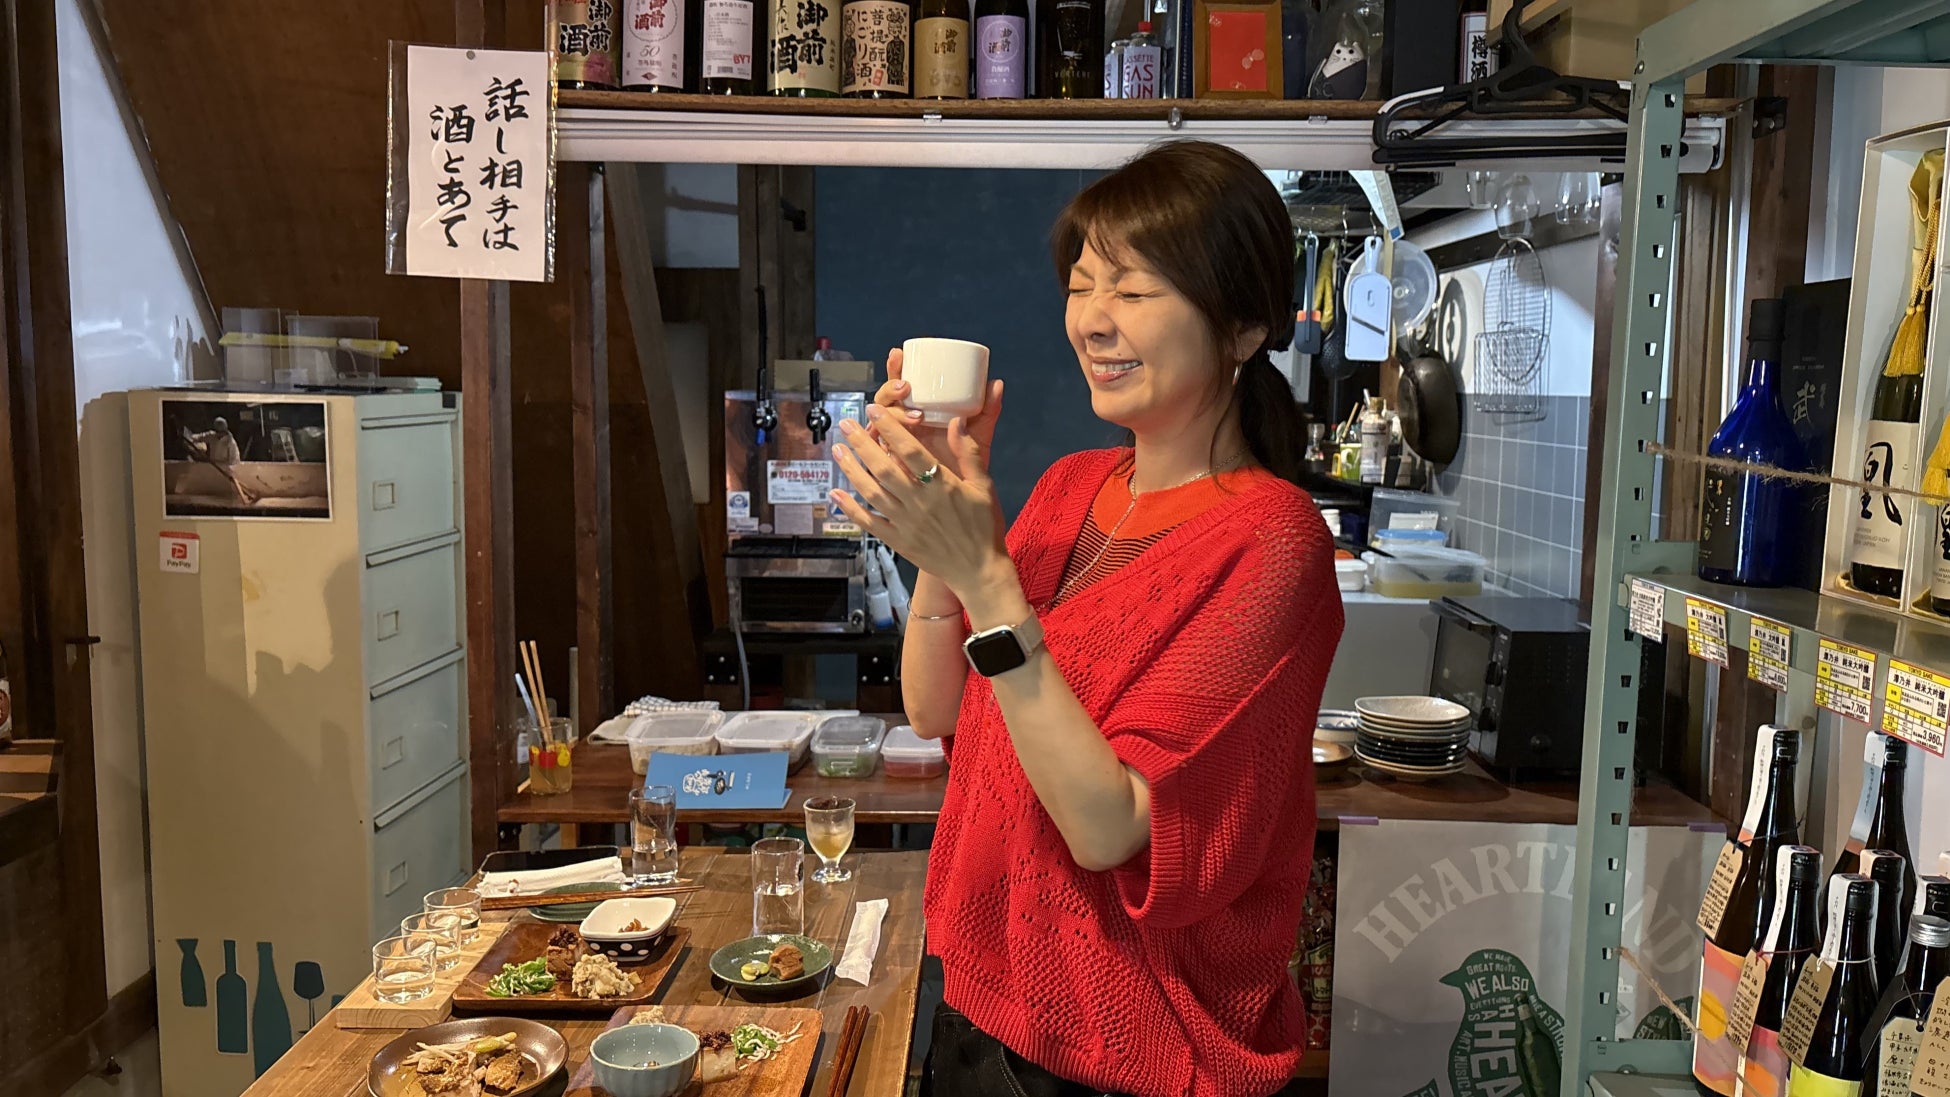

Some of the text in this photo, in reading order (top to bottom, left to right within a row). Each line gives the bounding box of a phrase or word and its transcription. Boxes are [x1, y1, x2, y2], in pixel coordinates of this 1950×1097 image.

[856, 10, 873, 78] にごり酒
[870, 8, 887, 62] 菩提酛
[640, 44, 660, 57] 50
[1124, 64, 1154, 82] GAS
[1123, 83, 1154, 99] SUN
[480, 77, 530, 251] 話し相手は
[429, 104, 476, 248] 酒とあて
[167, 559, 191, 568] PayPay
[1466, 962, 1494, 976] GREAT
[1464, 974, 1530, 1000] WE ALSO
